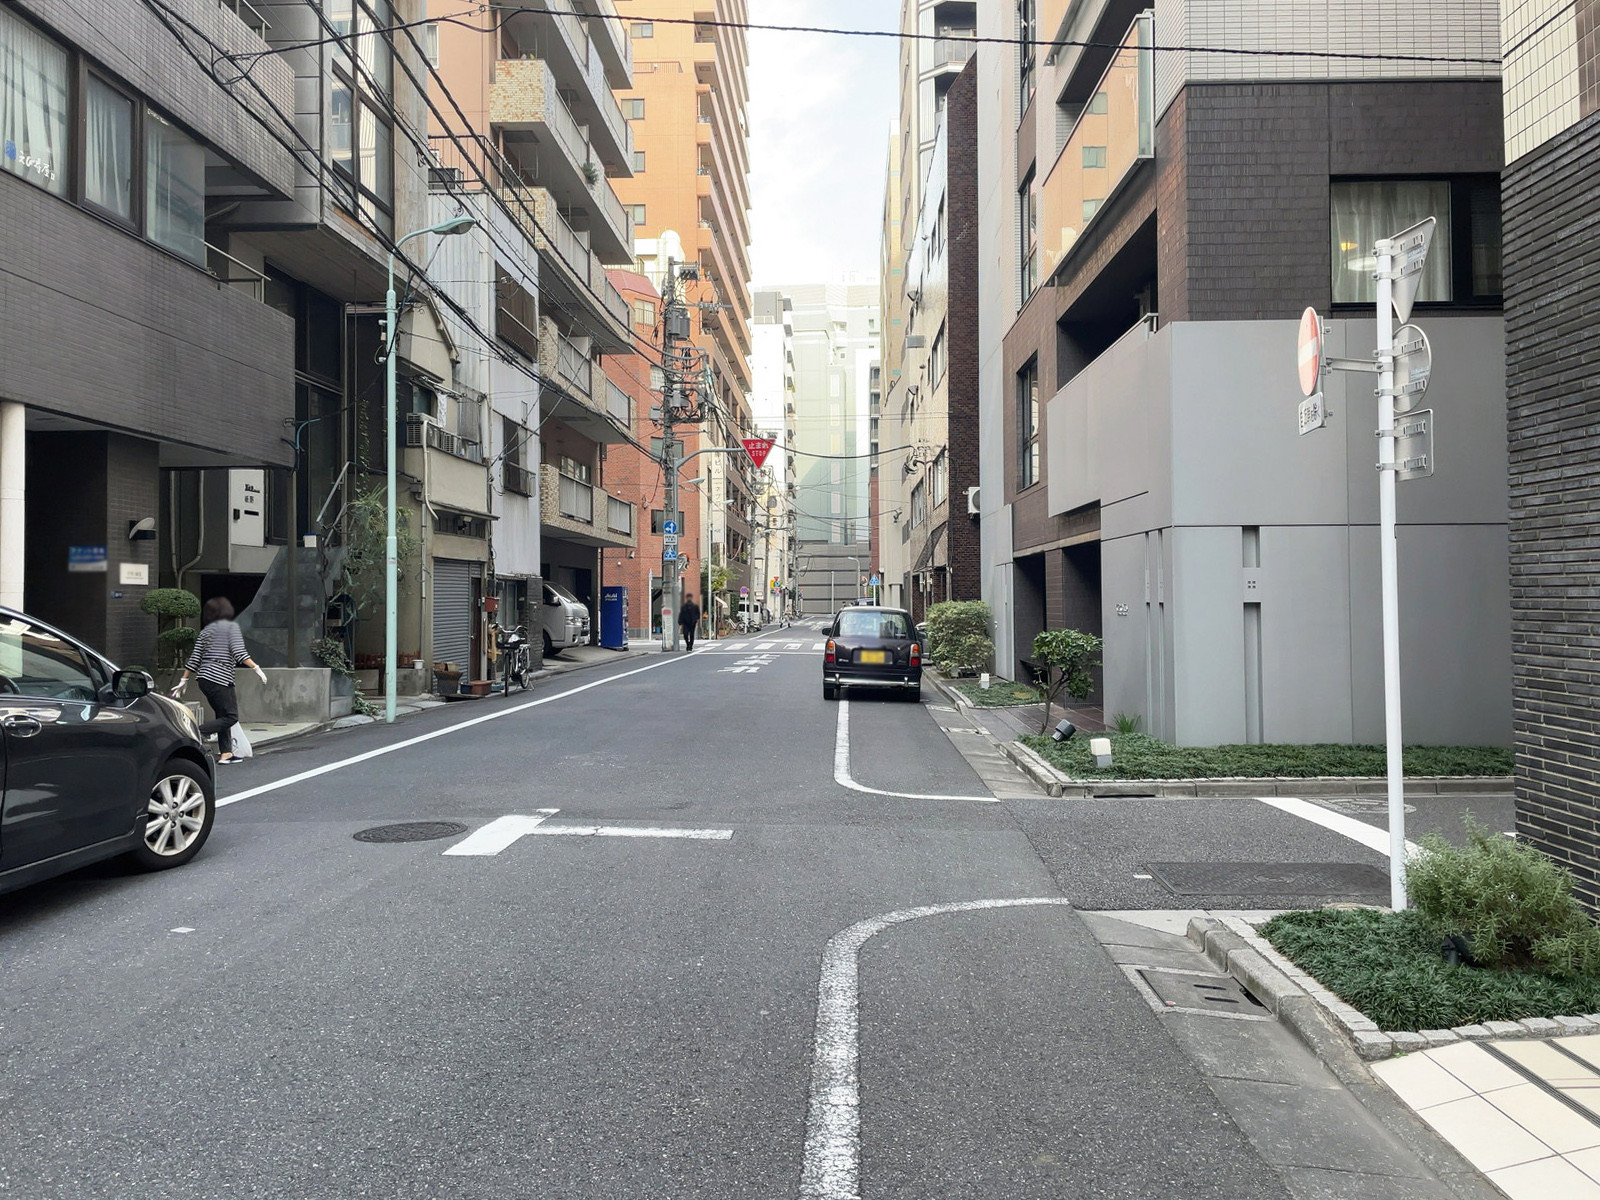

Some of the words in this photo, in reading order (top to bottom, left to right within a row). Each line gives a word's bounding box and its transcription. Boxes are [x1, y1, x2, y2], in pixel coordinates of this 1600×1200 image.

[749, 442, 769, 450] 止まれ
[717, 654, 780, 673] 止まれ
